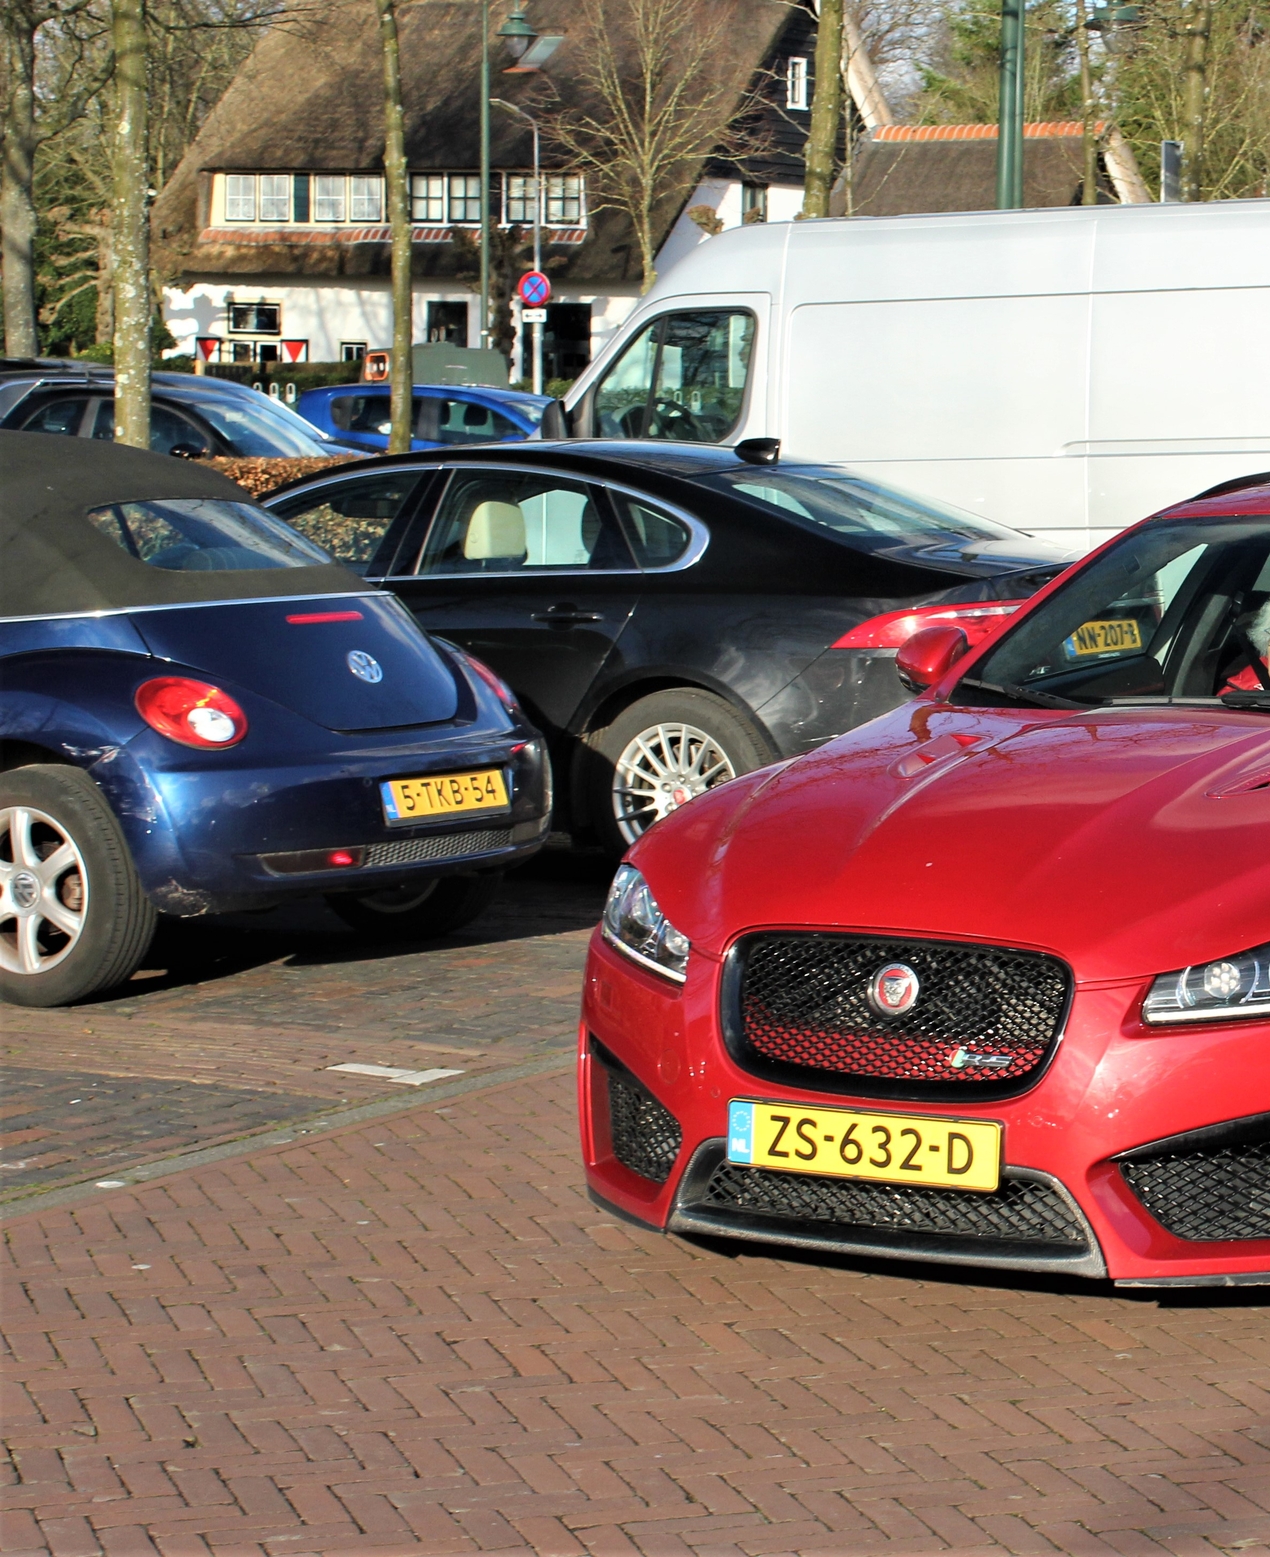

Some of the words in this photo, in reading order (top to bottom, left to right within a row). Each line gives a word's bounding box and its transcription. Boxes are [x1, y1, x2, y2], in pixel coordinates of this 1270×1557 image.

[400, 775, 497, 811] 5-TKB-54
[731, 1137, 750, 1154] NL
[767, 1114, 974, 1175] ZS-632-D
